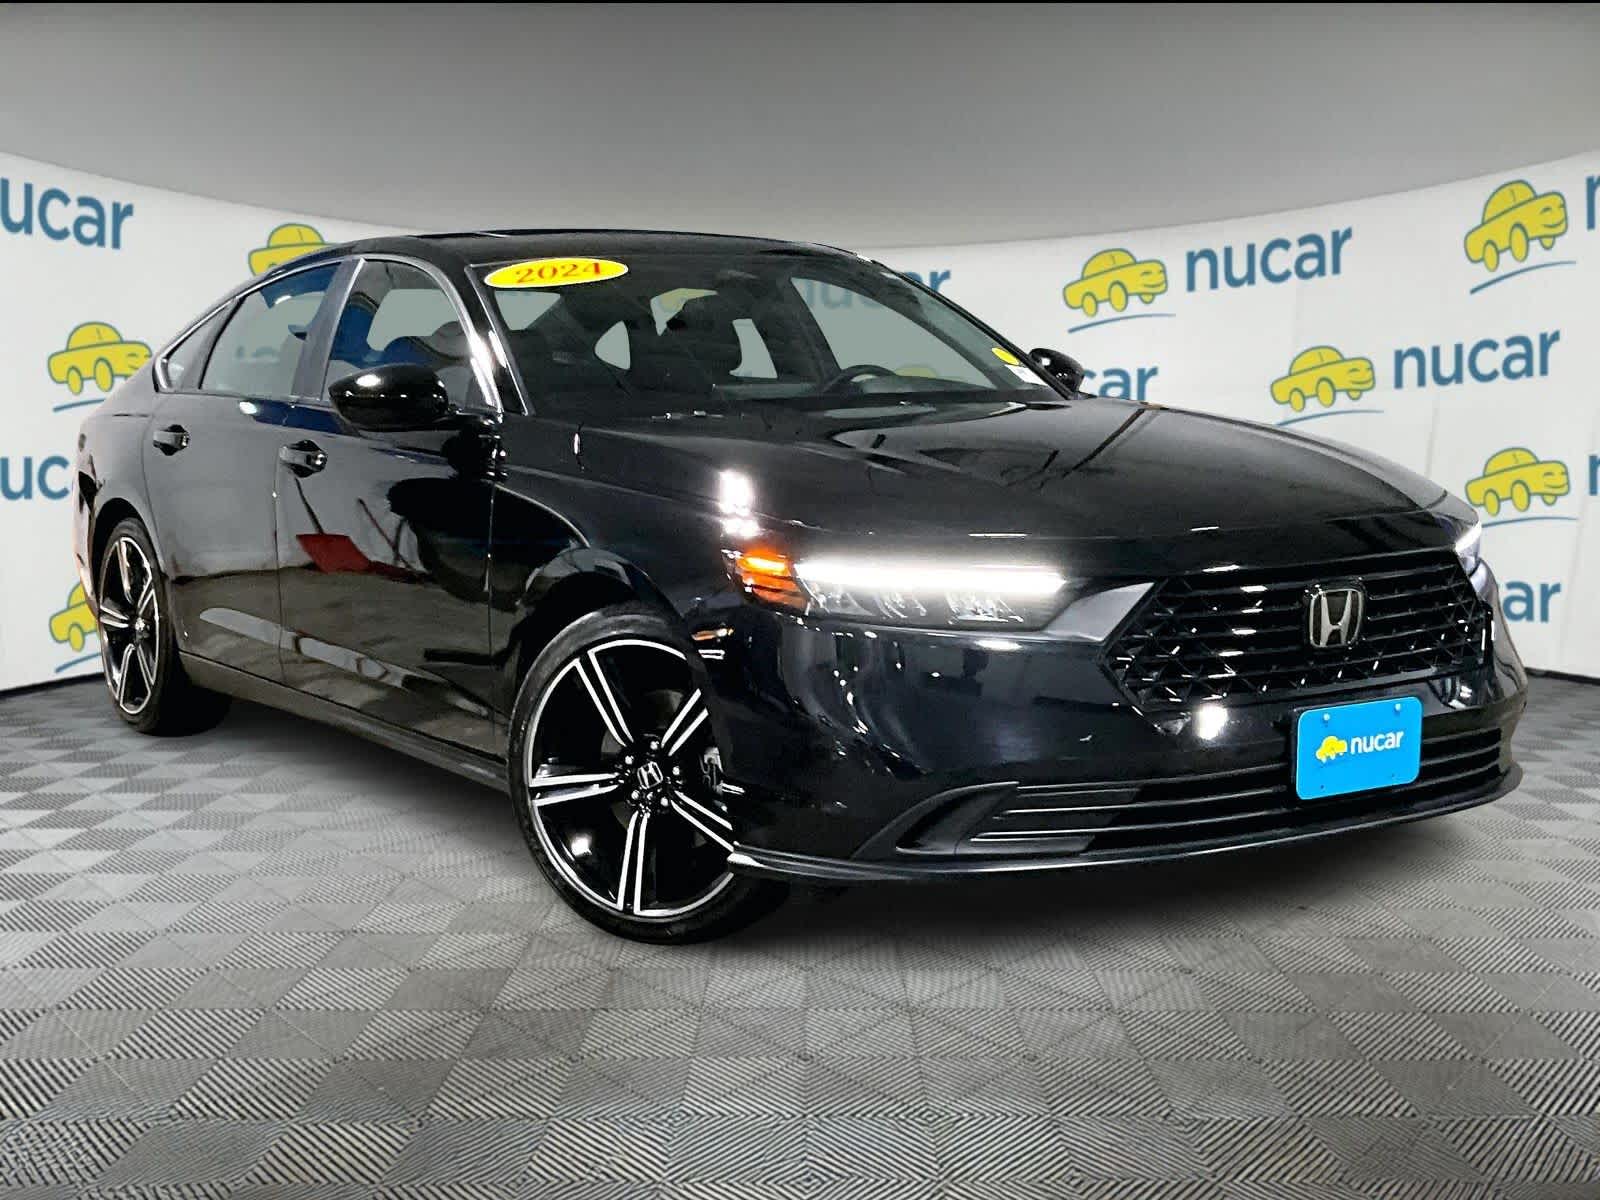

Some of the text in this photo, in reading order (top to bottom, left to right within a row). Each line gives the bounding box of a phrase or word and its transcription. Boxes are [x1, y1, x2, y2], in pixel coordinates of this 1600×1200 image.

[516, 262, 600, 283] 2024
[1186, 226, 1353, 292] nucar
[1394, 330, 1560, 389] nucar
[1350, 730, 1404, 754] nucar
